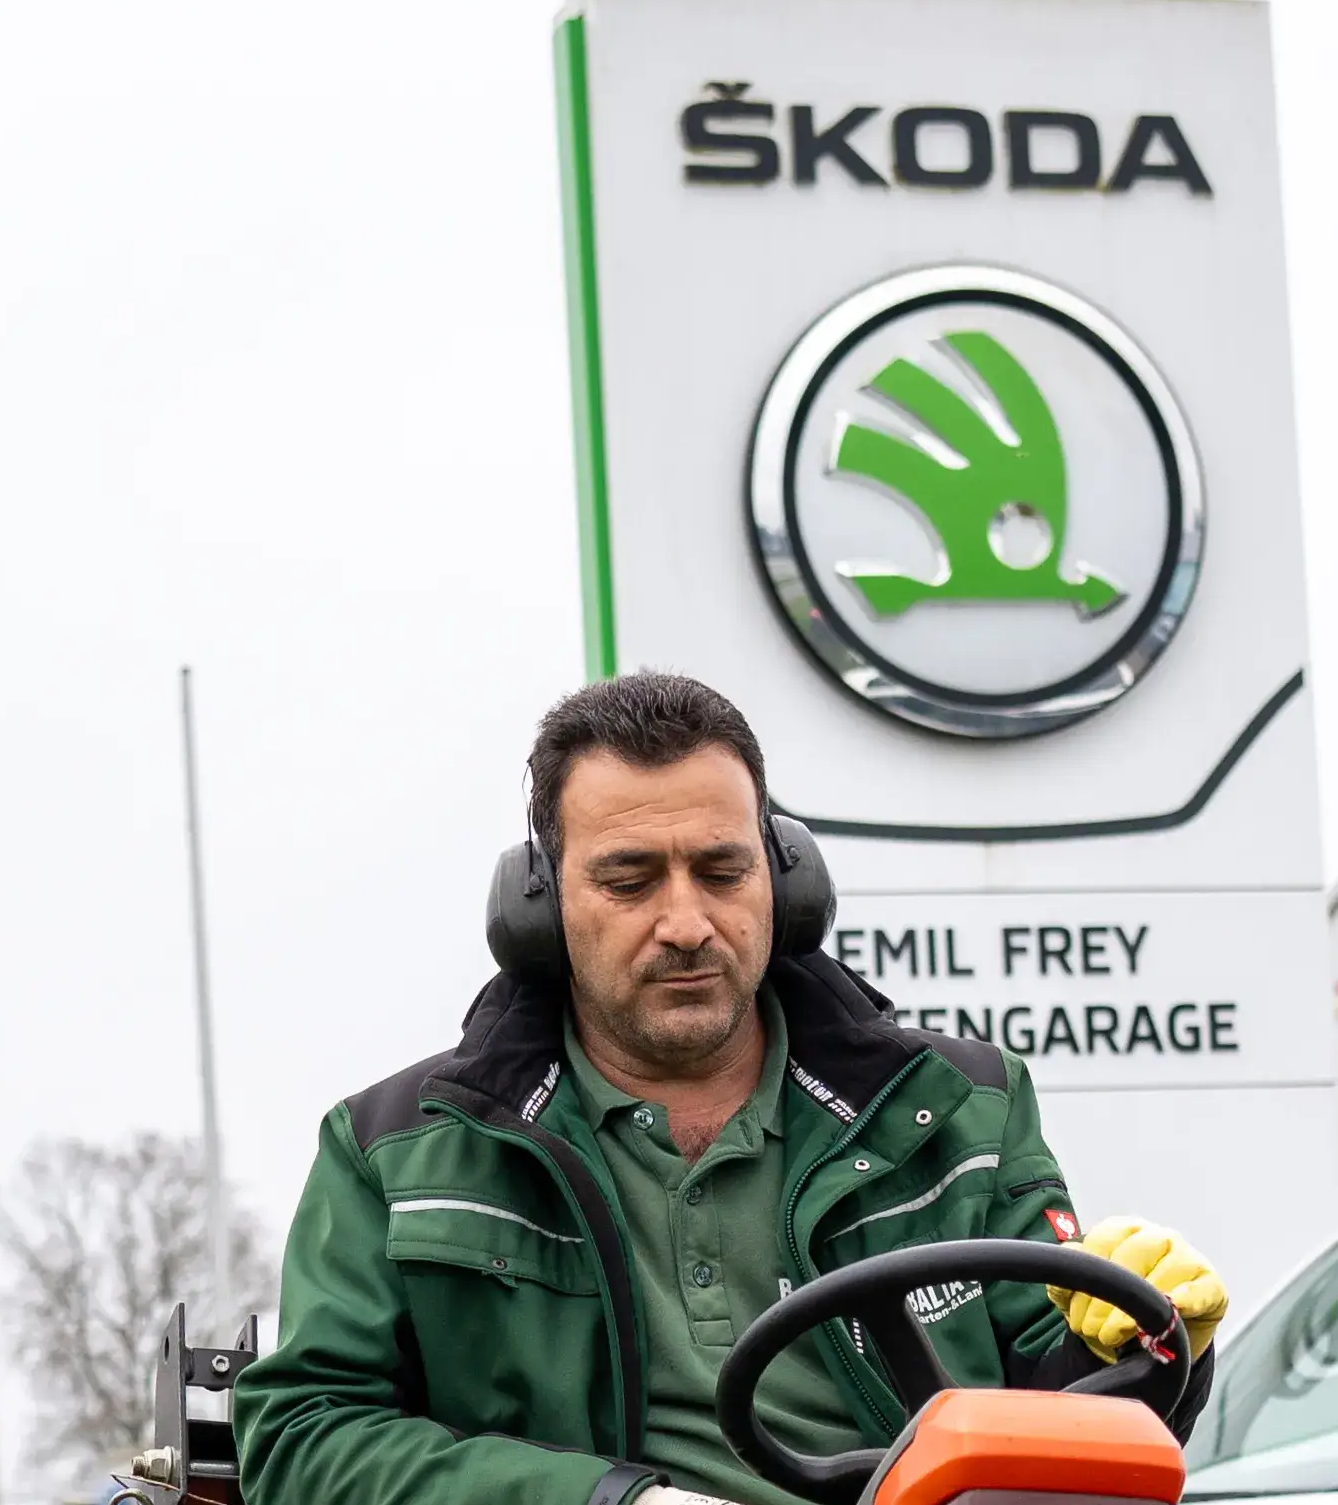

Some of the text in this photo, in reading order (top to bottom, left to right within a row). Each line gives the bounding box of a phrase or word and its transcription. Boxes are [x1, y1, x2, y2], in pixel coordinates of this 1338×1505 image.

[680, 81, 1215, 199] ŠKODA
[836, 924, 1150, 979] EMIL FREY
